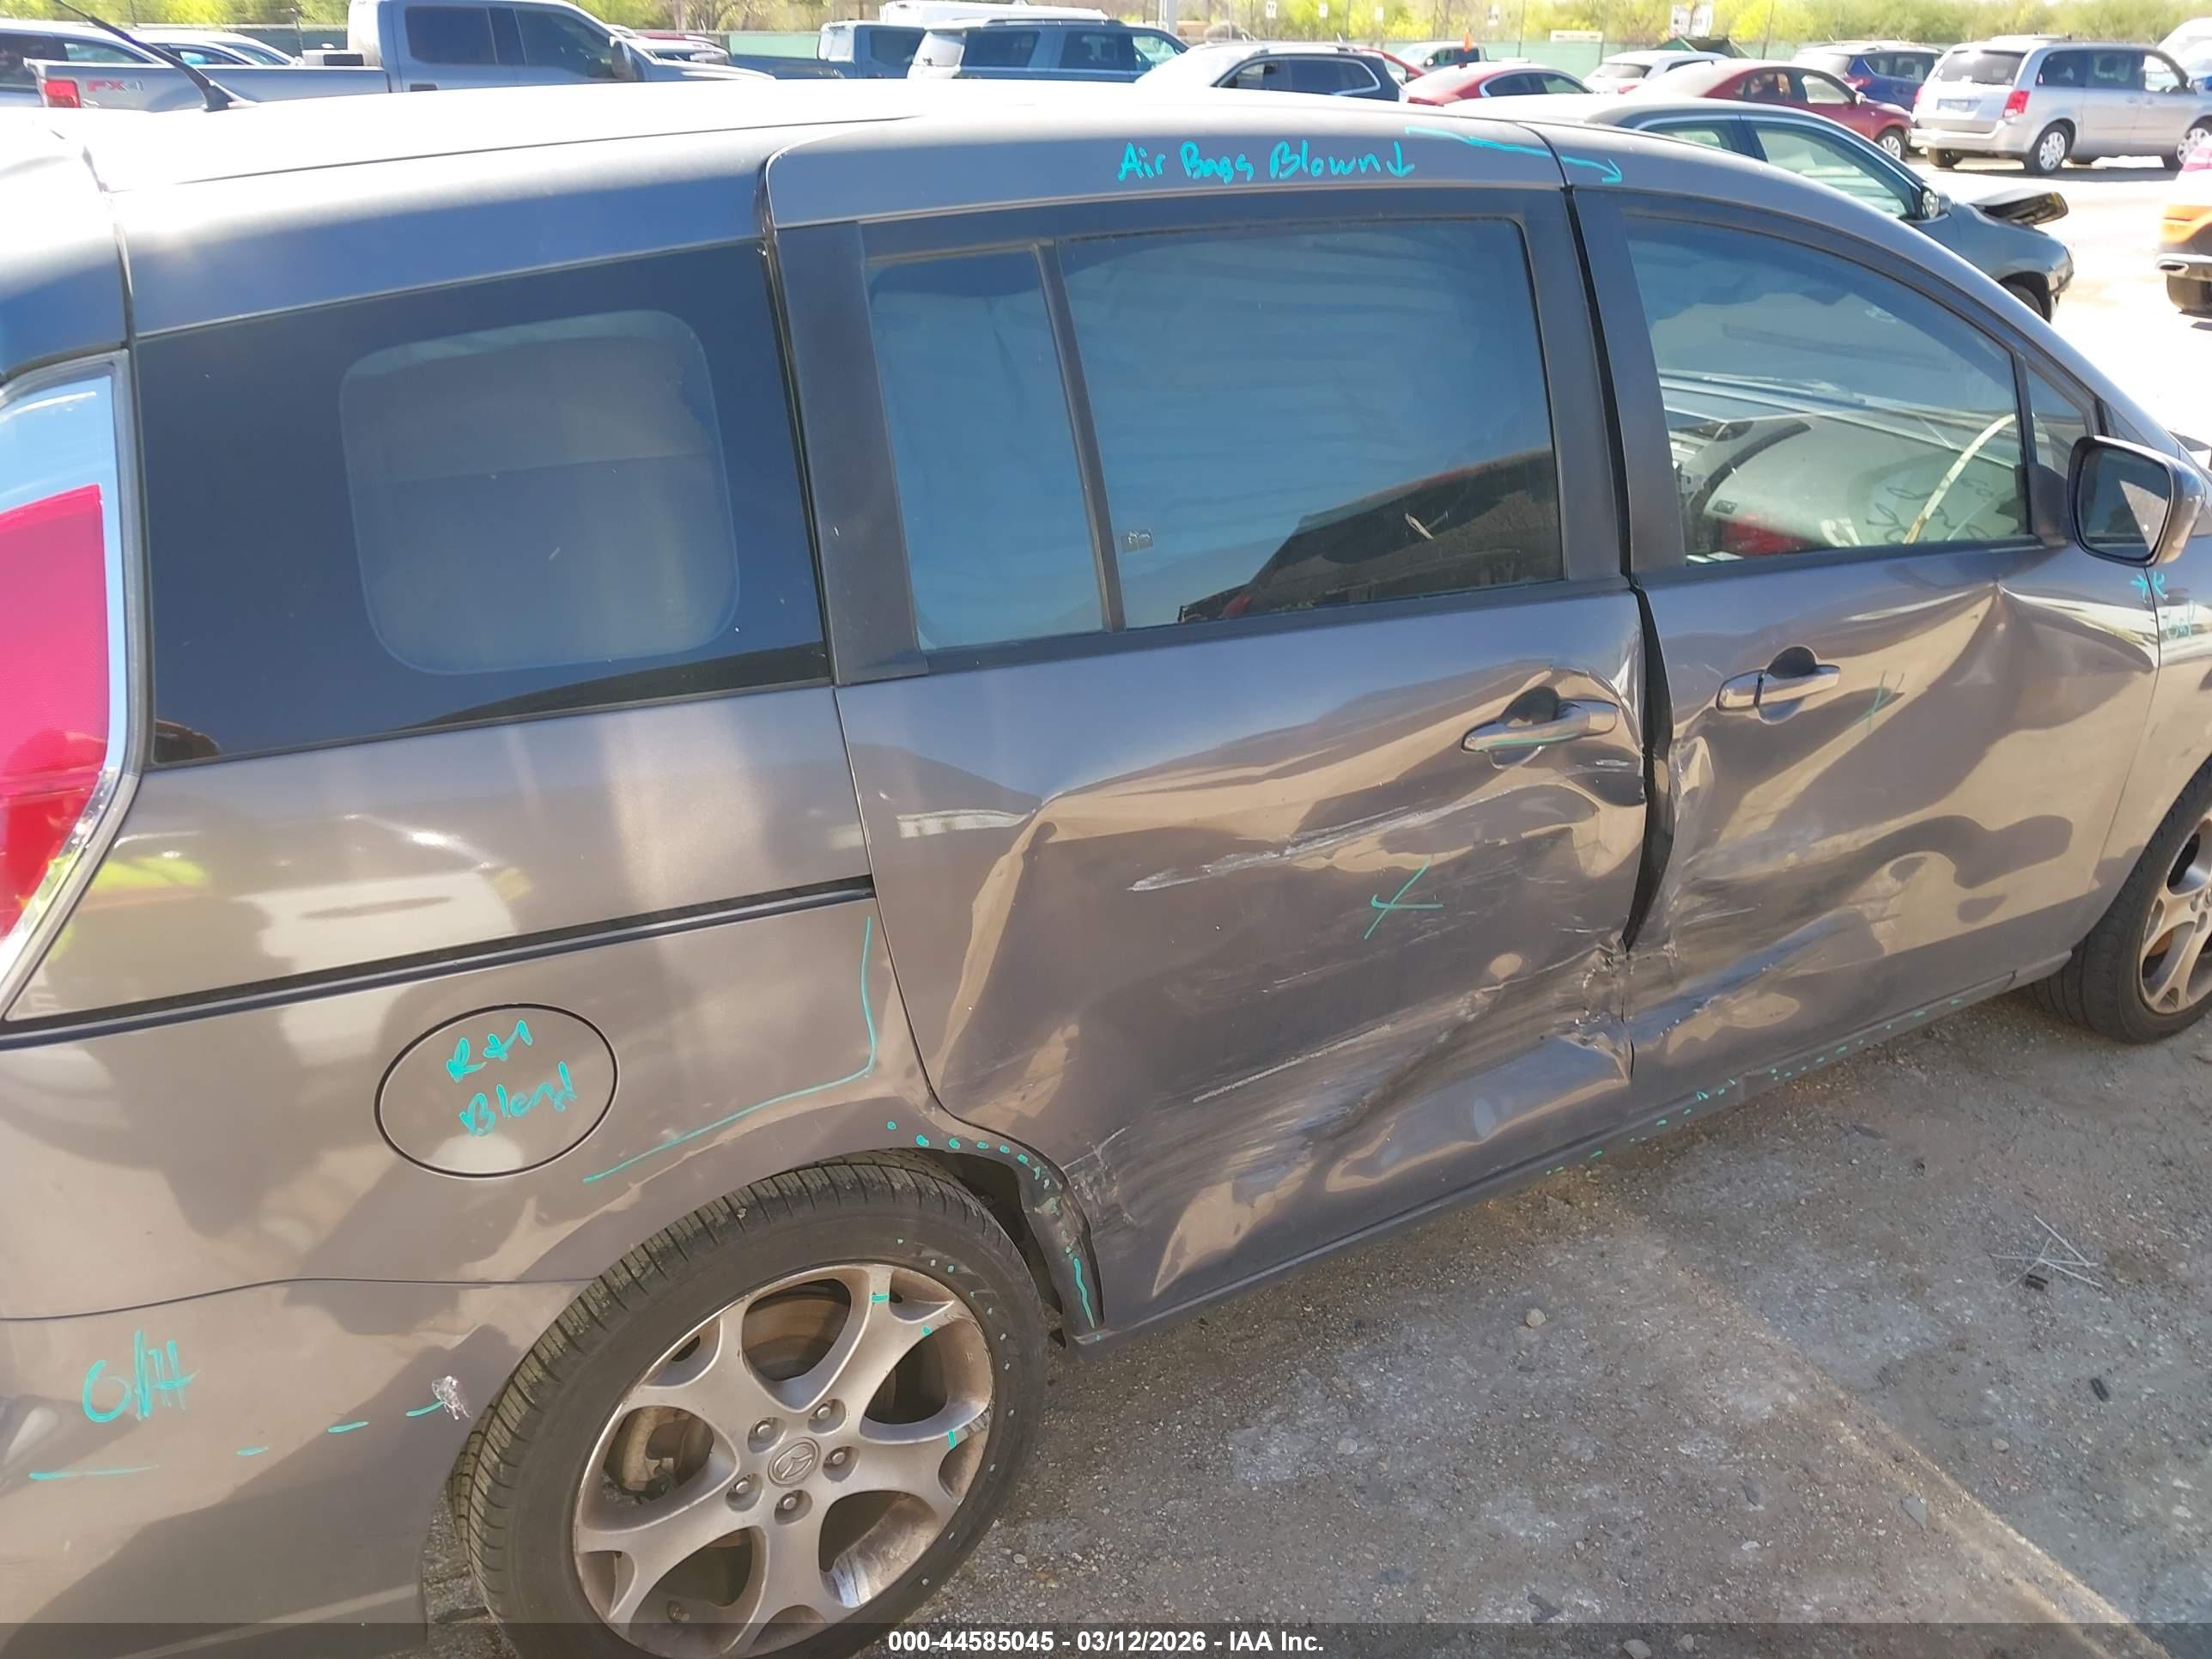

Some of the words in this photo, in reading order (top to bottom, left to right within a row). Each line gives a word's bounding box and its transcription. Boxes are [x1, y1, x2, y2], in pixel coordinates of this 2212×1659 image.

[1117, 143, 1165, 180] Air
[1179, 141, 1255, 185] Bags
[1269, 139, 1382, 179] Blown
[459, 1061, 577, 1137] Blend
